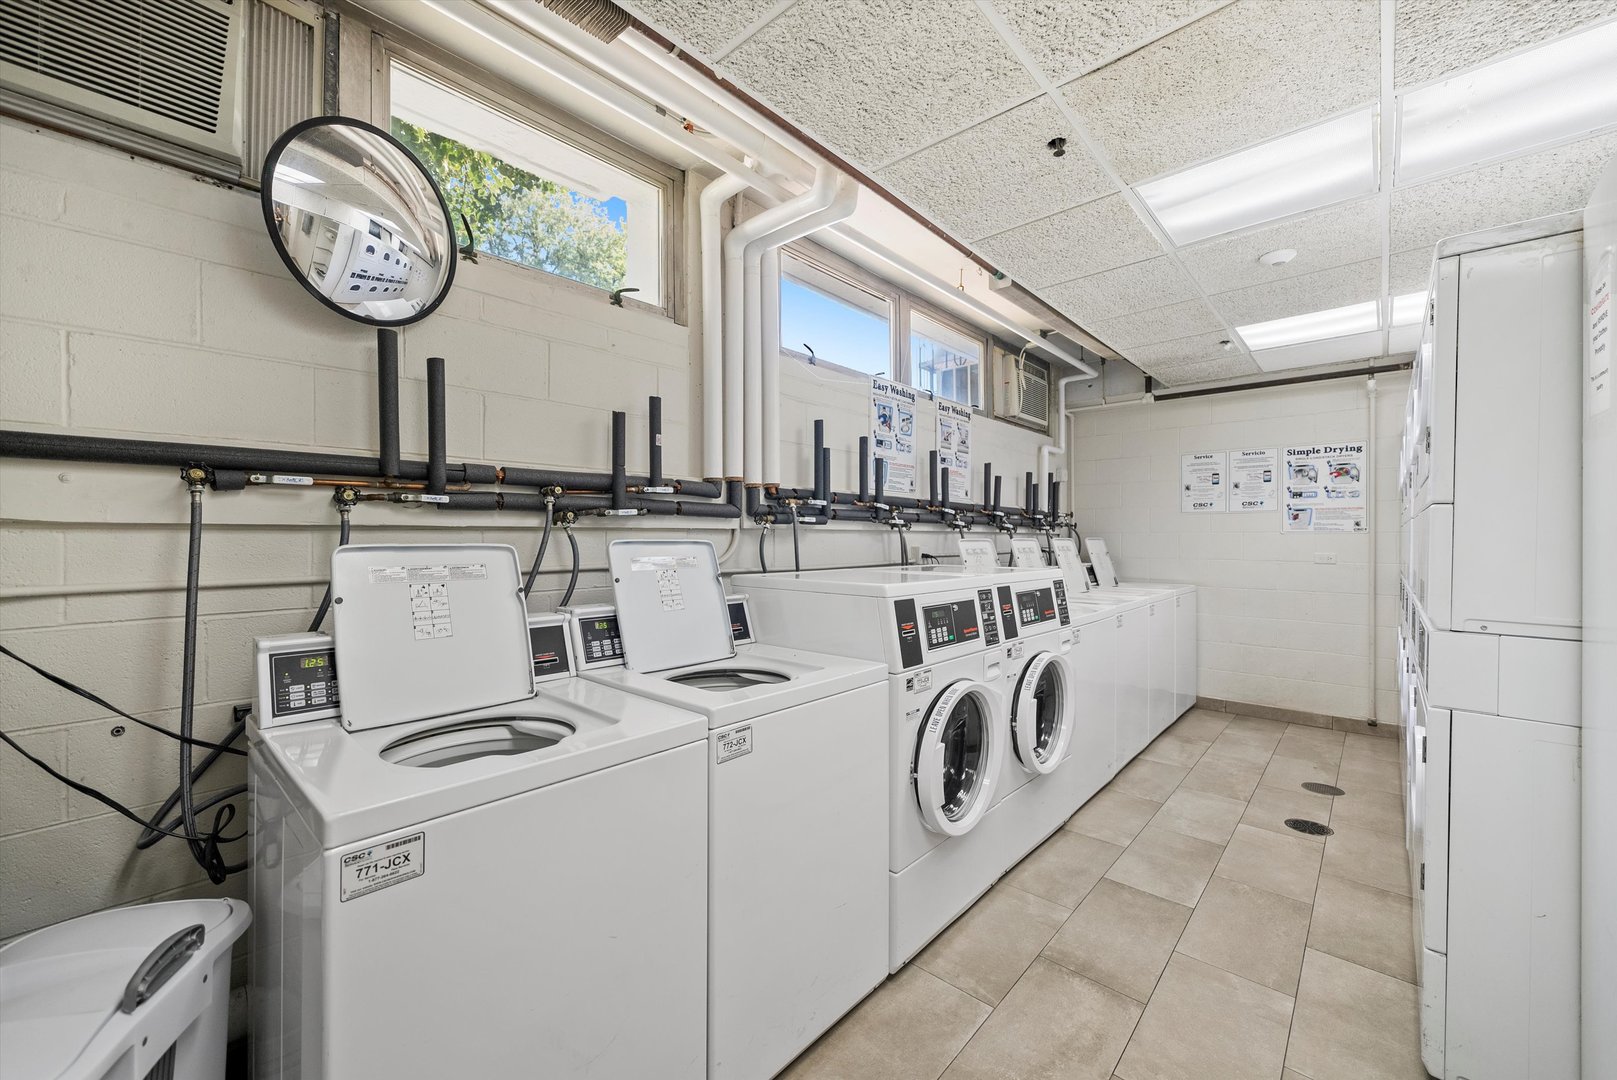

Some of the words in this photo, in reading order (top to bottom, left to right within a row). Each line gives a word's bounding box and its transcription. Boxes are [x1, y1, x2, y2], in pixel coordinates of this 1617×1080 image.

[872, 379, 889, 394] Easy
[890, 384, 916, 403] Washing
[938, 401, 950, 415] Easy
[951, 405, 971, 421] Washing
[1286, 447, 1321, 457] Simple
[1324, 445, 1363, 454] Drying
[929, 717, 941, 733] LEAVE
[935, 706, 947, 717] OPEN
[941, 695, 953, 705] WHEN
[723, 736, 747, 750] 772-JCX
[343, 852, 366, 864] CSC
[355, 852, 411, 879] 771-JCX
